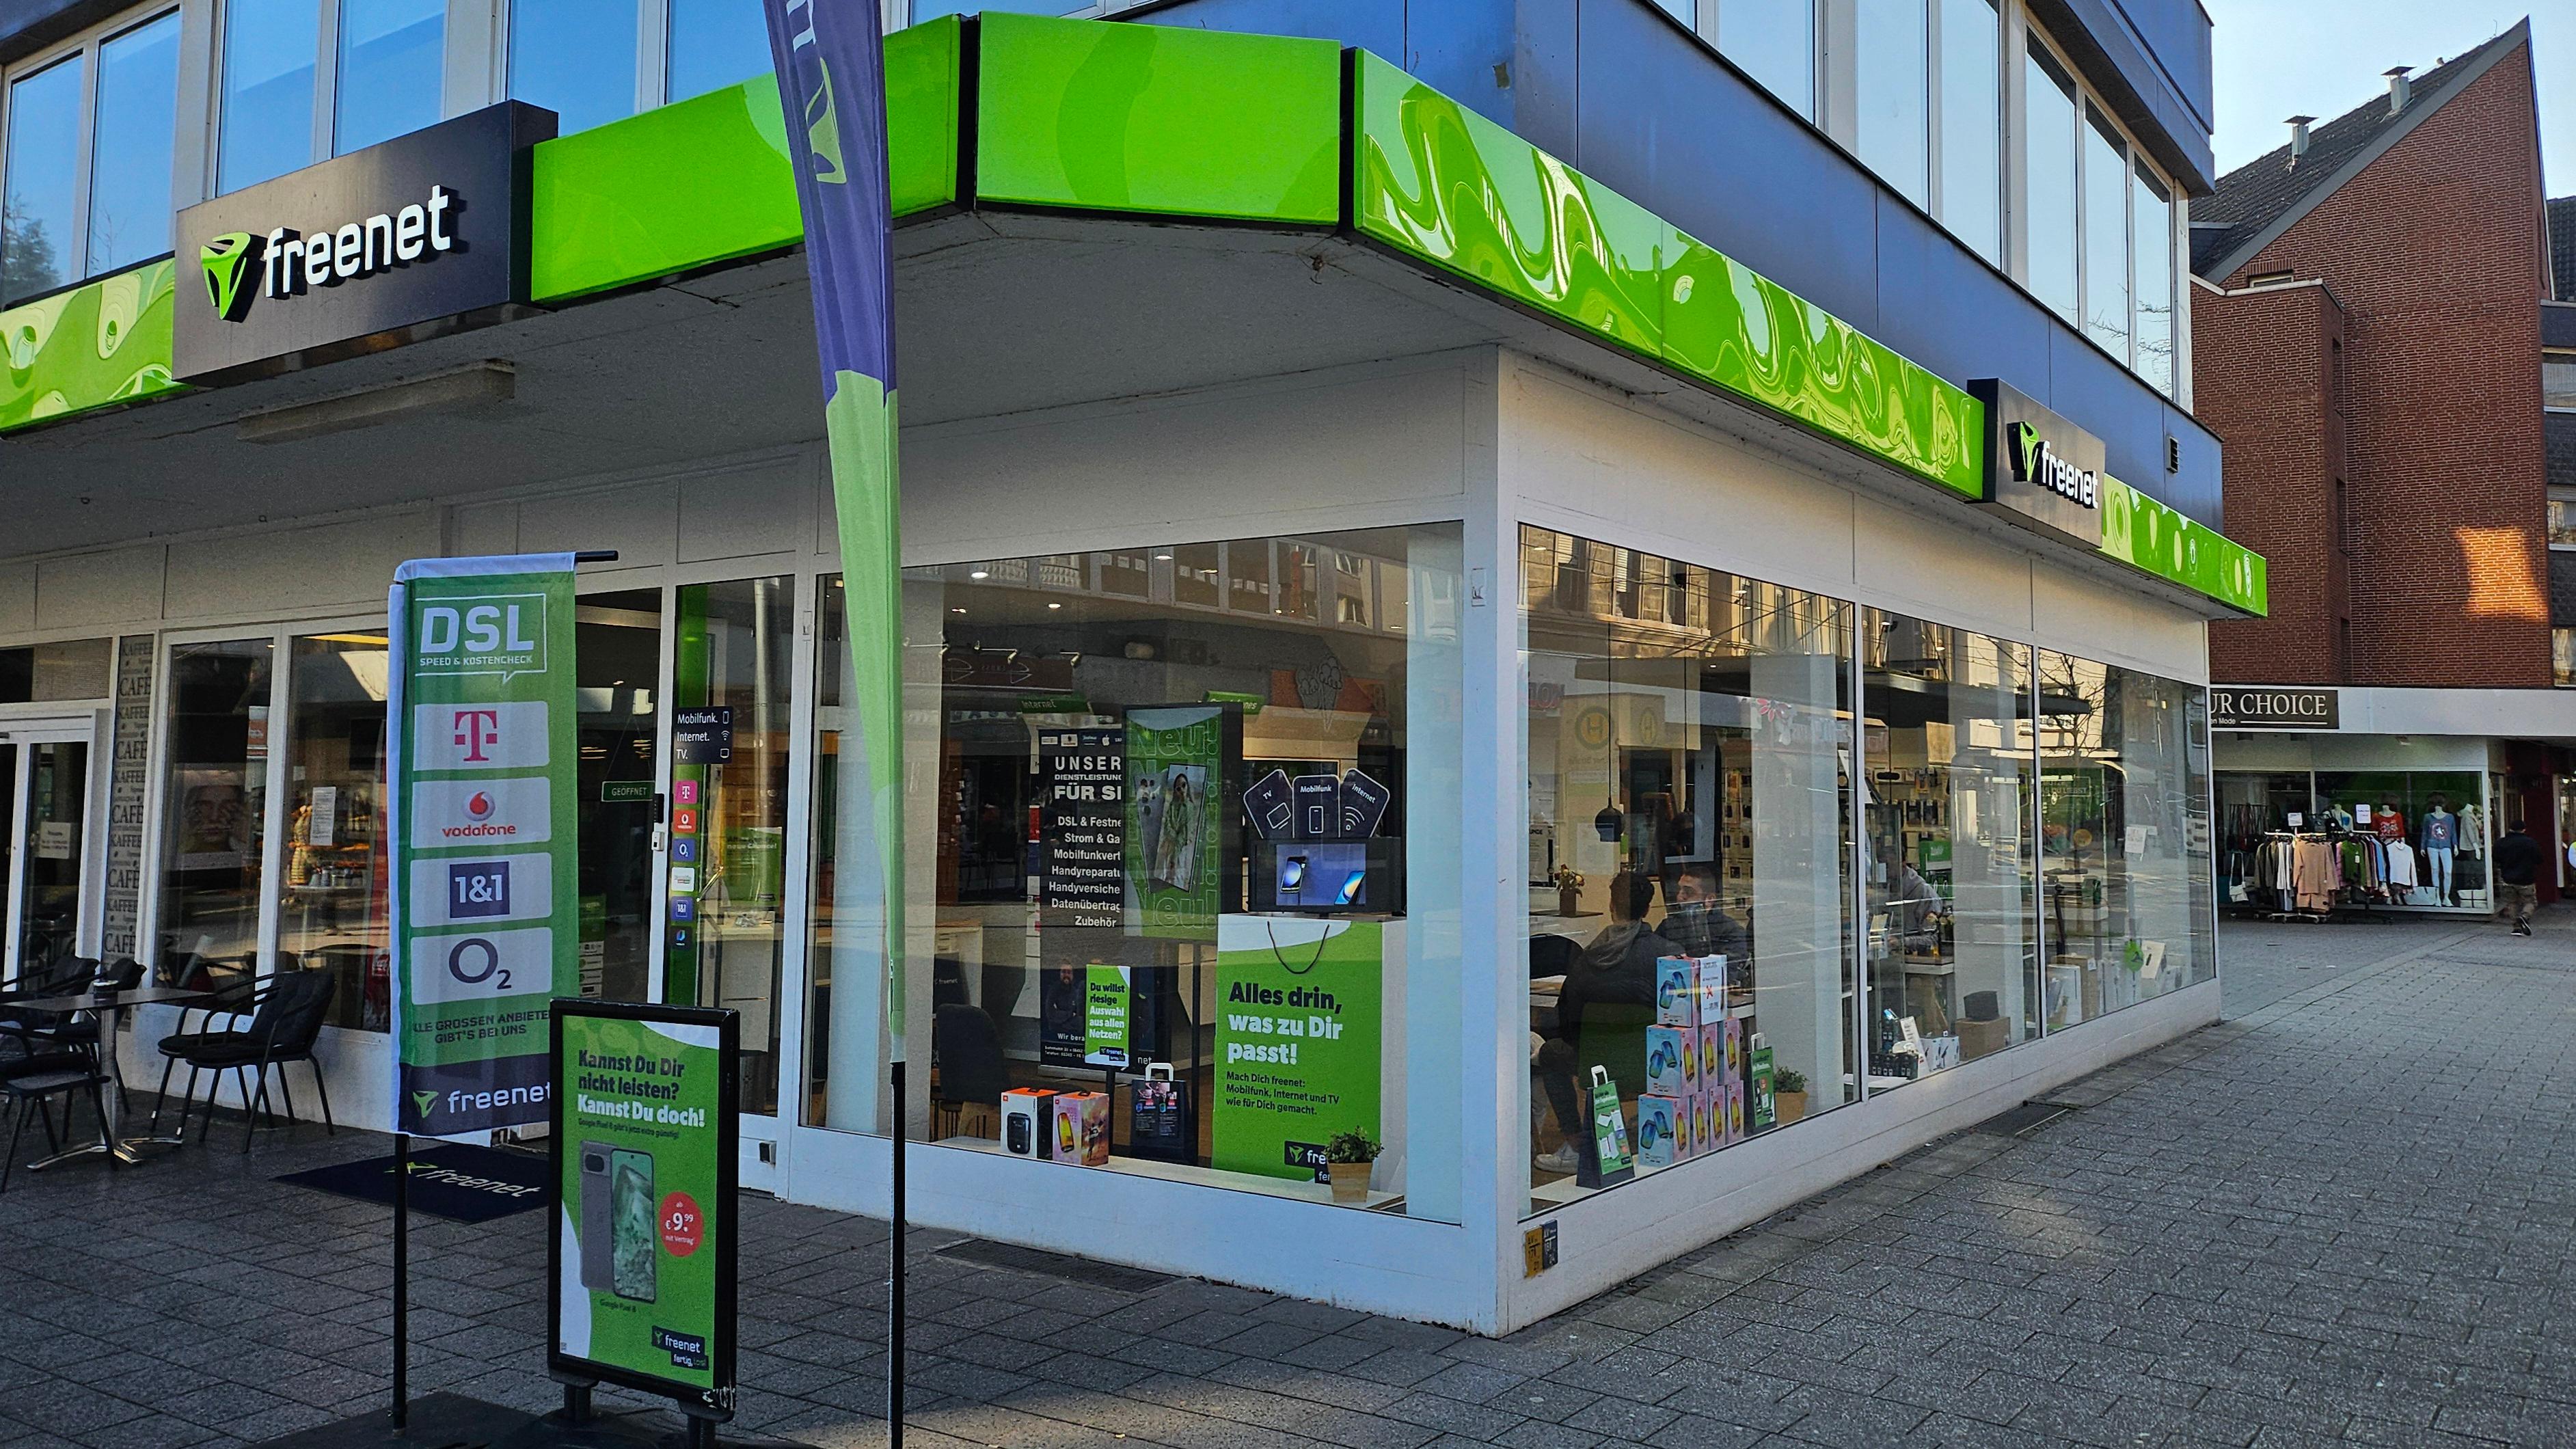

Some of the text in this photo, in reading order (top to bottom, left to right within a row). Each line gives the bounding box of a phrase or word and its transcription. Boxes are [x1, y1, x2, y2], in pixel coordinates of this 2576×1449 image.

[264, 185, 450, 297] freenet
[2042, 441, 2098, 509] freenet
[420, 605, 534, 653] DSL
[420, 655, 532, 666] SPEED & KOSTENCHECK
[2240, 694, 2328, 716] CHOICE
[677, 712, 718, 724] Mobilfunk.
[677, 731, 710, 742] Internet.
[676, 748, 688, 760] TV.
[1055, 756, 1121, 770] UNSER
[1054, 782, 1095, 800] FÜR
[1262, 783, 1377, 804] TV Mobilfunk Internet
[442, 823, 516, 838] vodafone
[1058, 817, 1077, 827] DSL
[1080, 817, 1088, 827] &
[1065, 833, 1120, 844] Strom & Ga
[455, 874, 502, 904] 1&1
[1049, 881, 1120, 895] Handyversiche
[1075, 915, 1116, 928] Zubehör
[1090, 982, 1125, 993] Du willst
[1090, 994, 1117, 1005] riesige
[1229, 981, 1343, 1014] Alles drin,
[1089, 1005, 1124, 1016] Auswahl
[435, 1014, 494, 1031] GROSSEN
[498, 1010, 550, 1024] ANBIETE
[1104, 1018, 1124, 1029] allen
[1228, 1013, 1343, 1040] was zu Dir
[435, 1025, 526, 1044] GIBT'S BEI UNS
[1089, 1029, 1122, 1040] Netzen?
[1228, 1041, 1298, 1065] passt!
[578, 1049, 685, 1078] Kannst Du Dir
[578, 1072, 679, 1100] nicht leisten?
[1226, 1071, 1305, 1087] Mach Dich freenet:
[1226, 1084, 1340, 1105] Mobilfunk, Internet und TV
[578, 1094, 705, 1128] Kannst Du doch!
[1226, 1096, 1318, 1115] wie für Dich gemacht.
[416, 1169, 541, 1197] freenet
[665, 1335, 701, 1353] freenet
